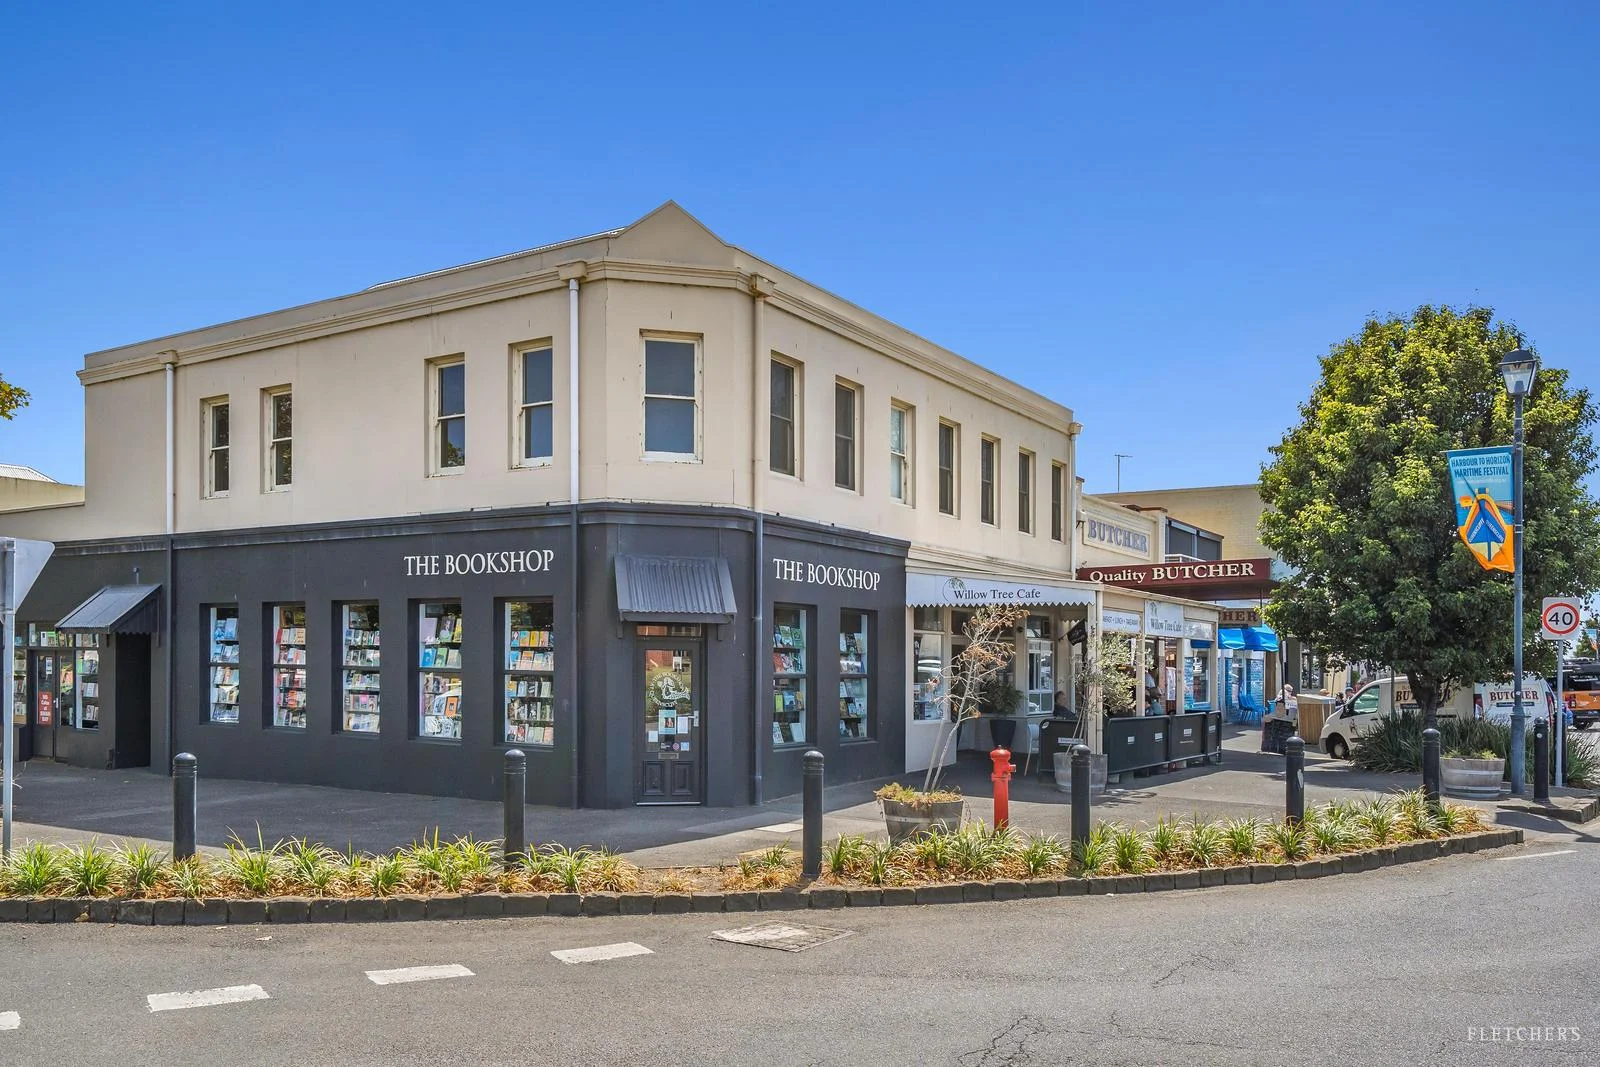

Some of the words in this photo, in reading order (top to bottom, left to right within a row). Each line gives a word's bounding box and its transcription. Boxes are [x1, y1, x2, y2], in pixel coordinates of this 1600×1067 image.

[1451, 457, 1478, 467] HARBOUR
[1479, 457, 1485, 465] TO
[1485, 455, 1511, 464] HORIZON
[1454, 467, 1482, 477] MARITIME
[1483, 466, 1509, 476] FESTIVAL
[1088, 519, 1147, 553] BUTCHER
[403, 555, 440, 576] THE
[444, 549, 554, 575] BOOKSHOP
[773, 558, 803, 582] THE
[807, 562, 880, 591] BOOKSHOP
[1089, 569, 1146, 584] Quality
[1151, 562, 1256, 580] BUTCHER
[953, 589, 987, 600] Willow
[990, 589, 1014, 599] Tree
[1016, 588, 1041, 599] Cafe
[1548, 612, 1573, 626] 40
